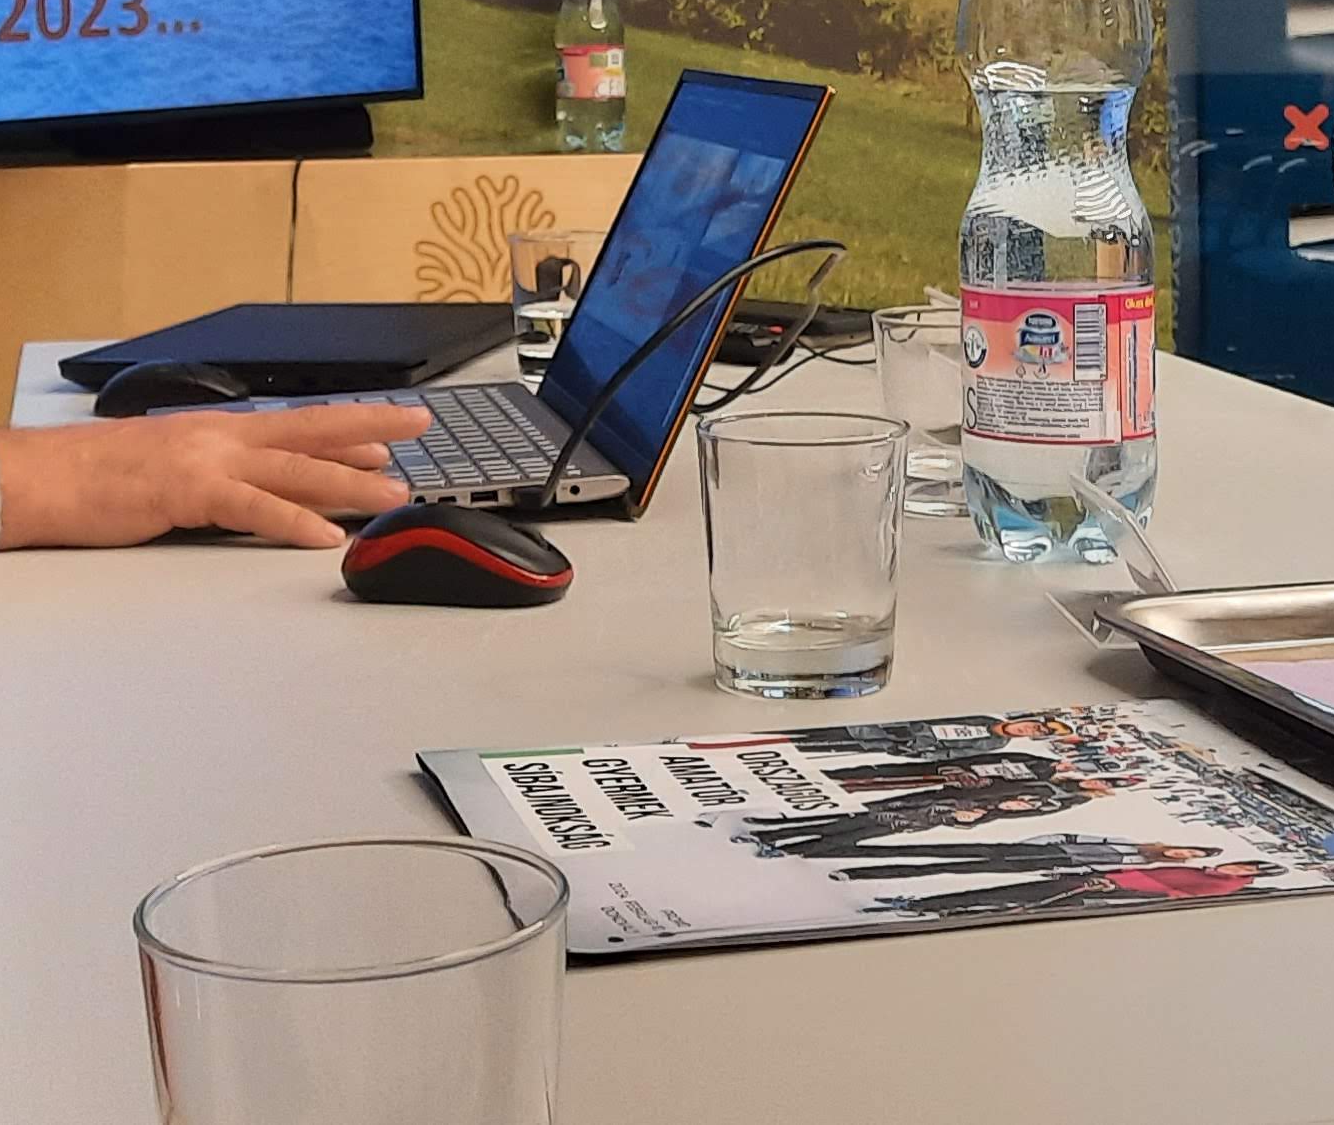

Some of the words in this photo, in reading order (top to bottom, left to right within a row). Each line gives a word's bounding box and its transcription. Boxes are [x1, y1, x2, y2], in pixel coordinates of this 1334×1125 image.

[502, 762, 612, 851] SÍBAJNOKSÁG
[582, 758, 675, 821] GYERMEK
[736, 751, 840, 812] ORSZÁGOS
